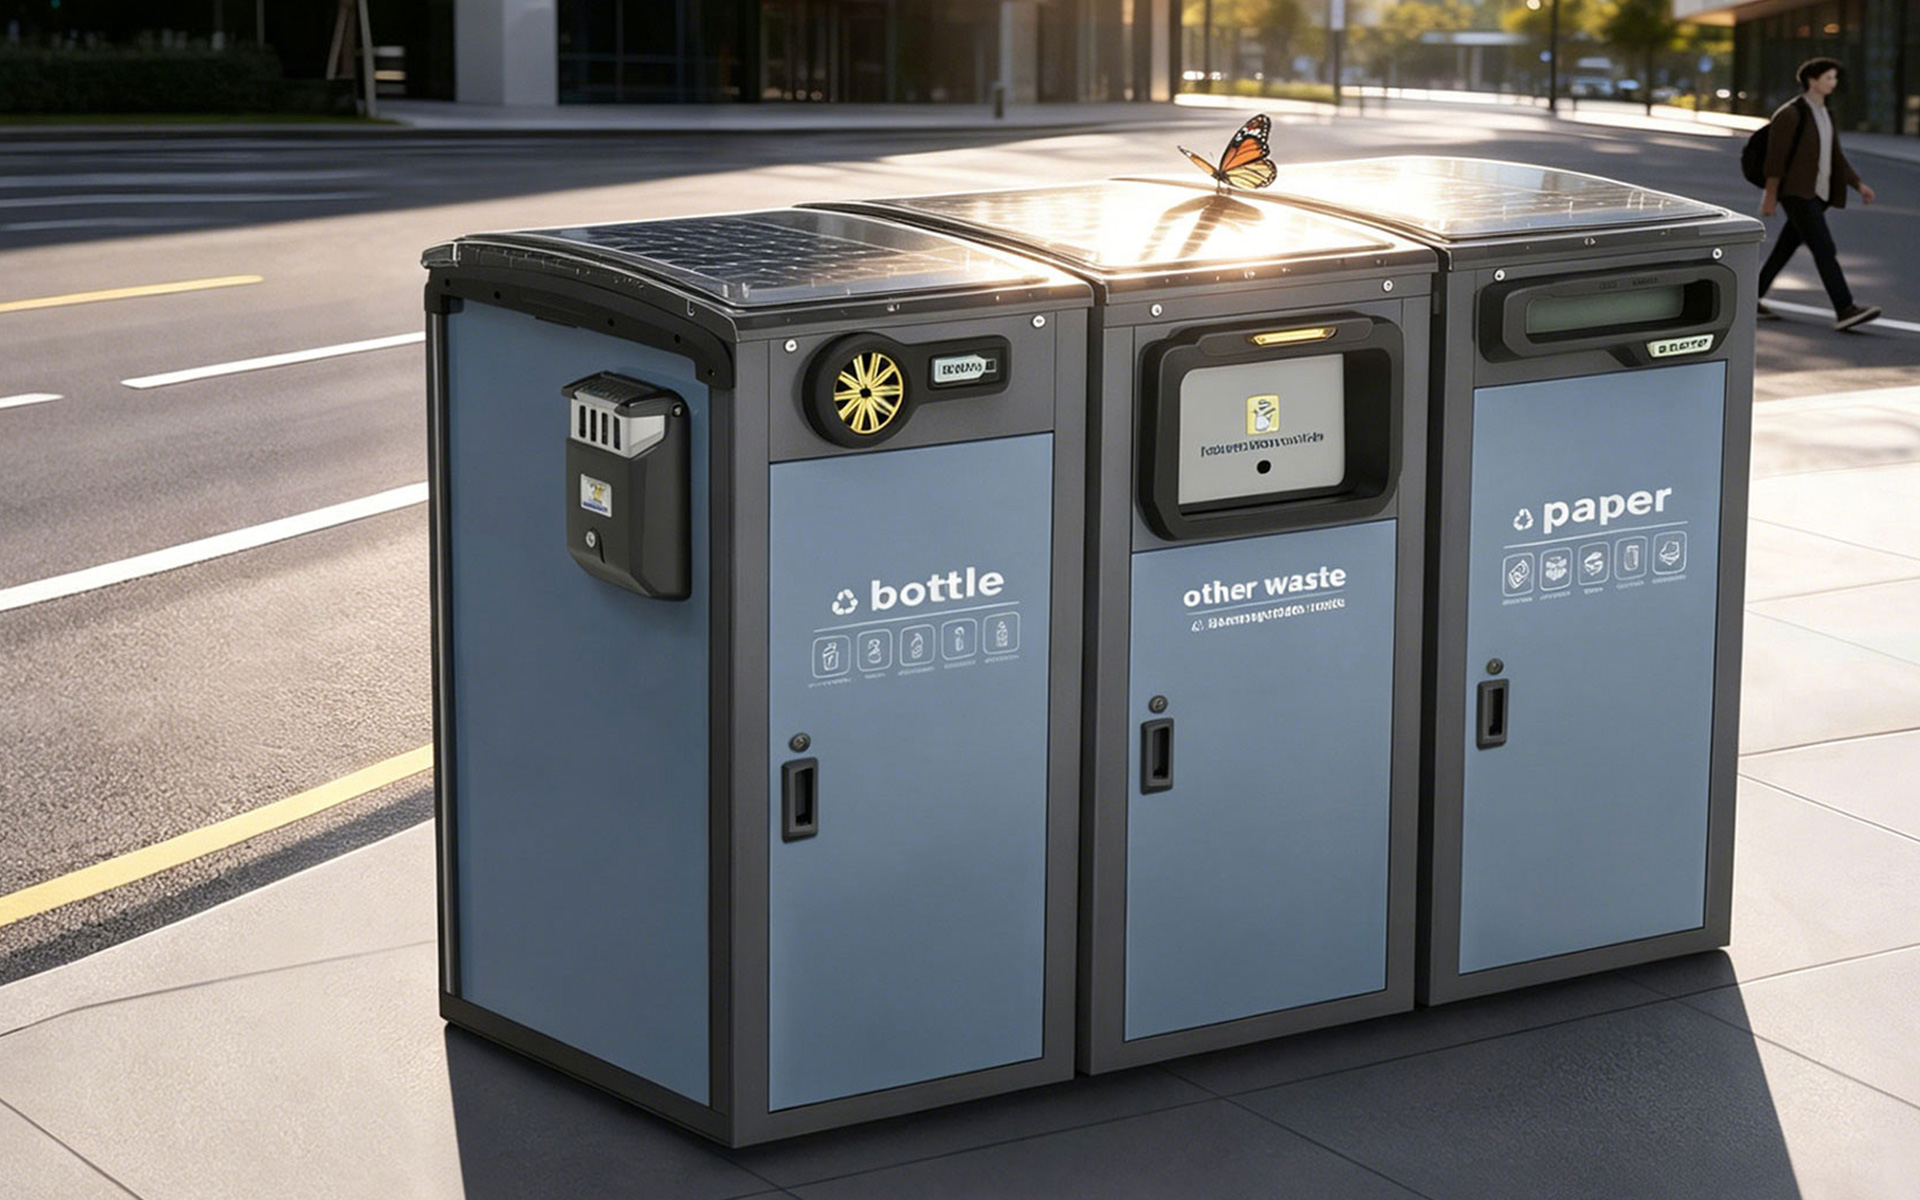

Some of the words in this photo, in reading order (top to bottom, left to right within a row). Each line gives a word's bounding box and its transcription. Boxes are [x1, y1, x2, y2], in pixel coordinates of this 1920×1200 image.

[1543, 487, 1672, 534] paper
[871, 567, 1004, 611] bottle
[1183, 580, 1258, 607] other
[1265, 566, 1346, 595] waste
